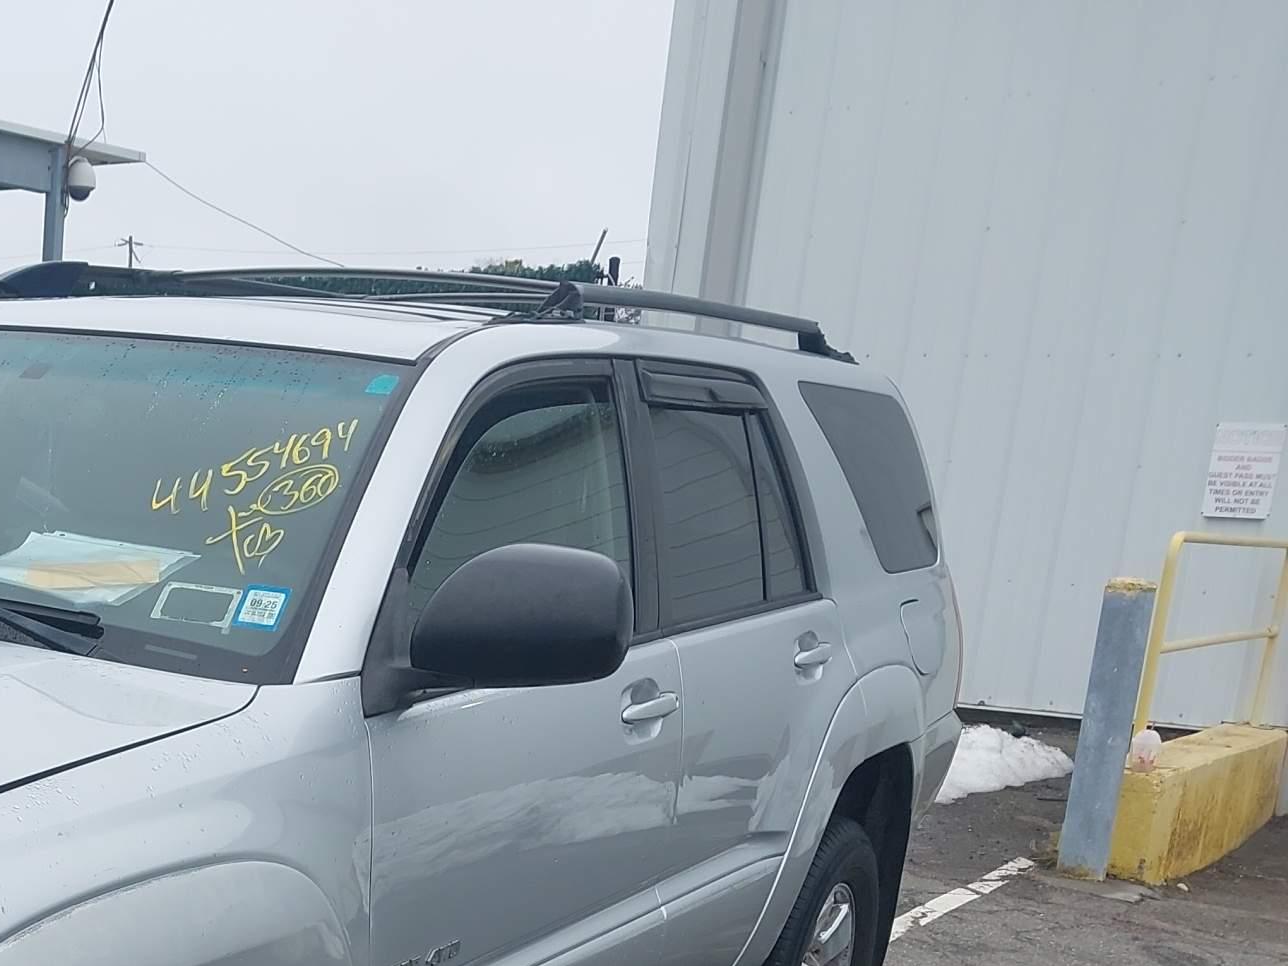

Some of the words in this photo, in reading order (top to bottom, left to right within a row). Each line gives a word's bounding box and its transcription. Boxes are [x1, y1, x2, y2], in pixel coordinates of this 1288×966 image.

[1258, 481, 1273, 489] ALL
[271, 472, 335, 511] 360
[1214, 506, 1257, 514] PERMITTED
